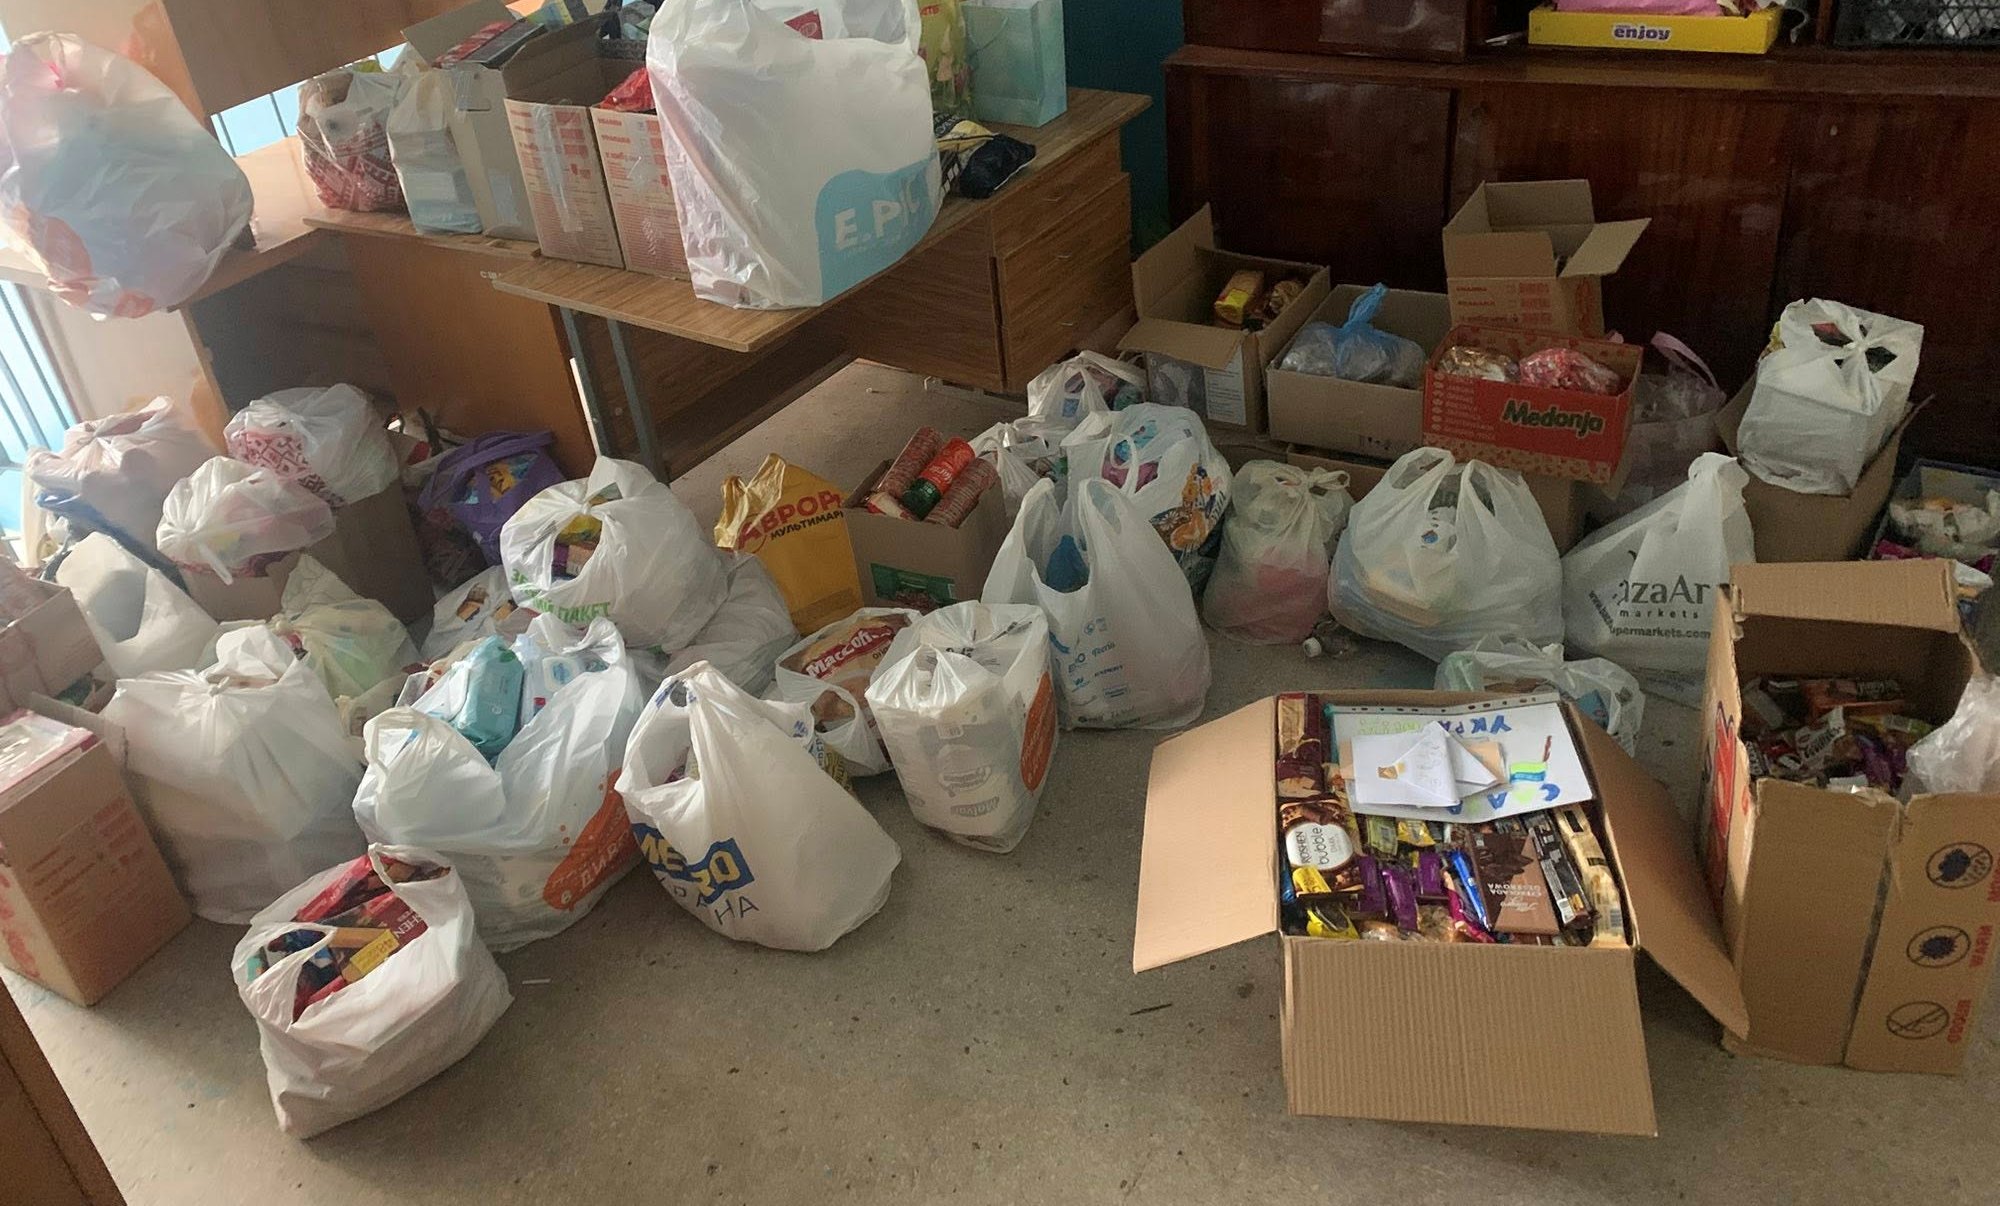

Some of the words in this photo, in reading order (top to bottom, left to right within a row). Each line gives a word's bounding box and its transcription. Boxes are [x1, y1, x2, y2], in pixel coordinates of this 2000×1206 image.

[1613, 24, 1671, 41] enjoy
[1501, 398, 1606, 439] Medonja
[770, 511, 844, 541] МУЛЬТИМАР
[1619, 608, 1699, 619] markets
